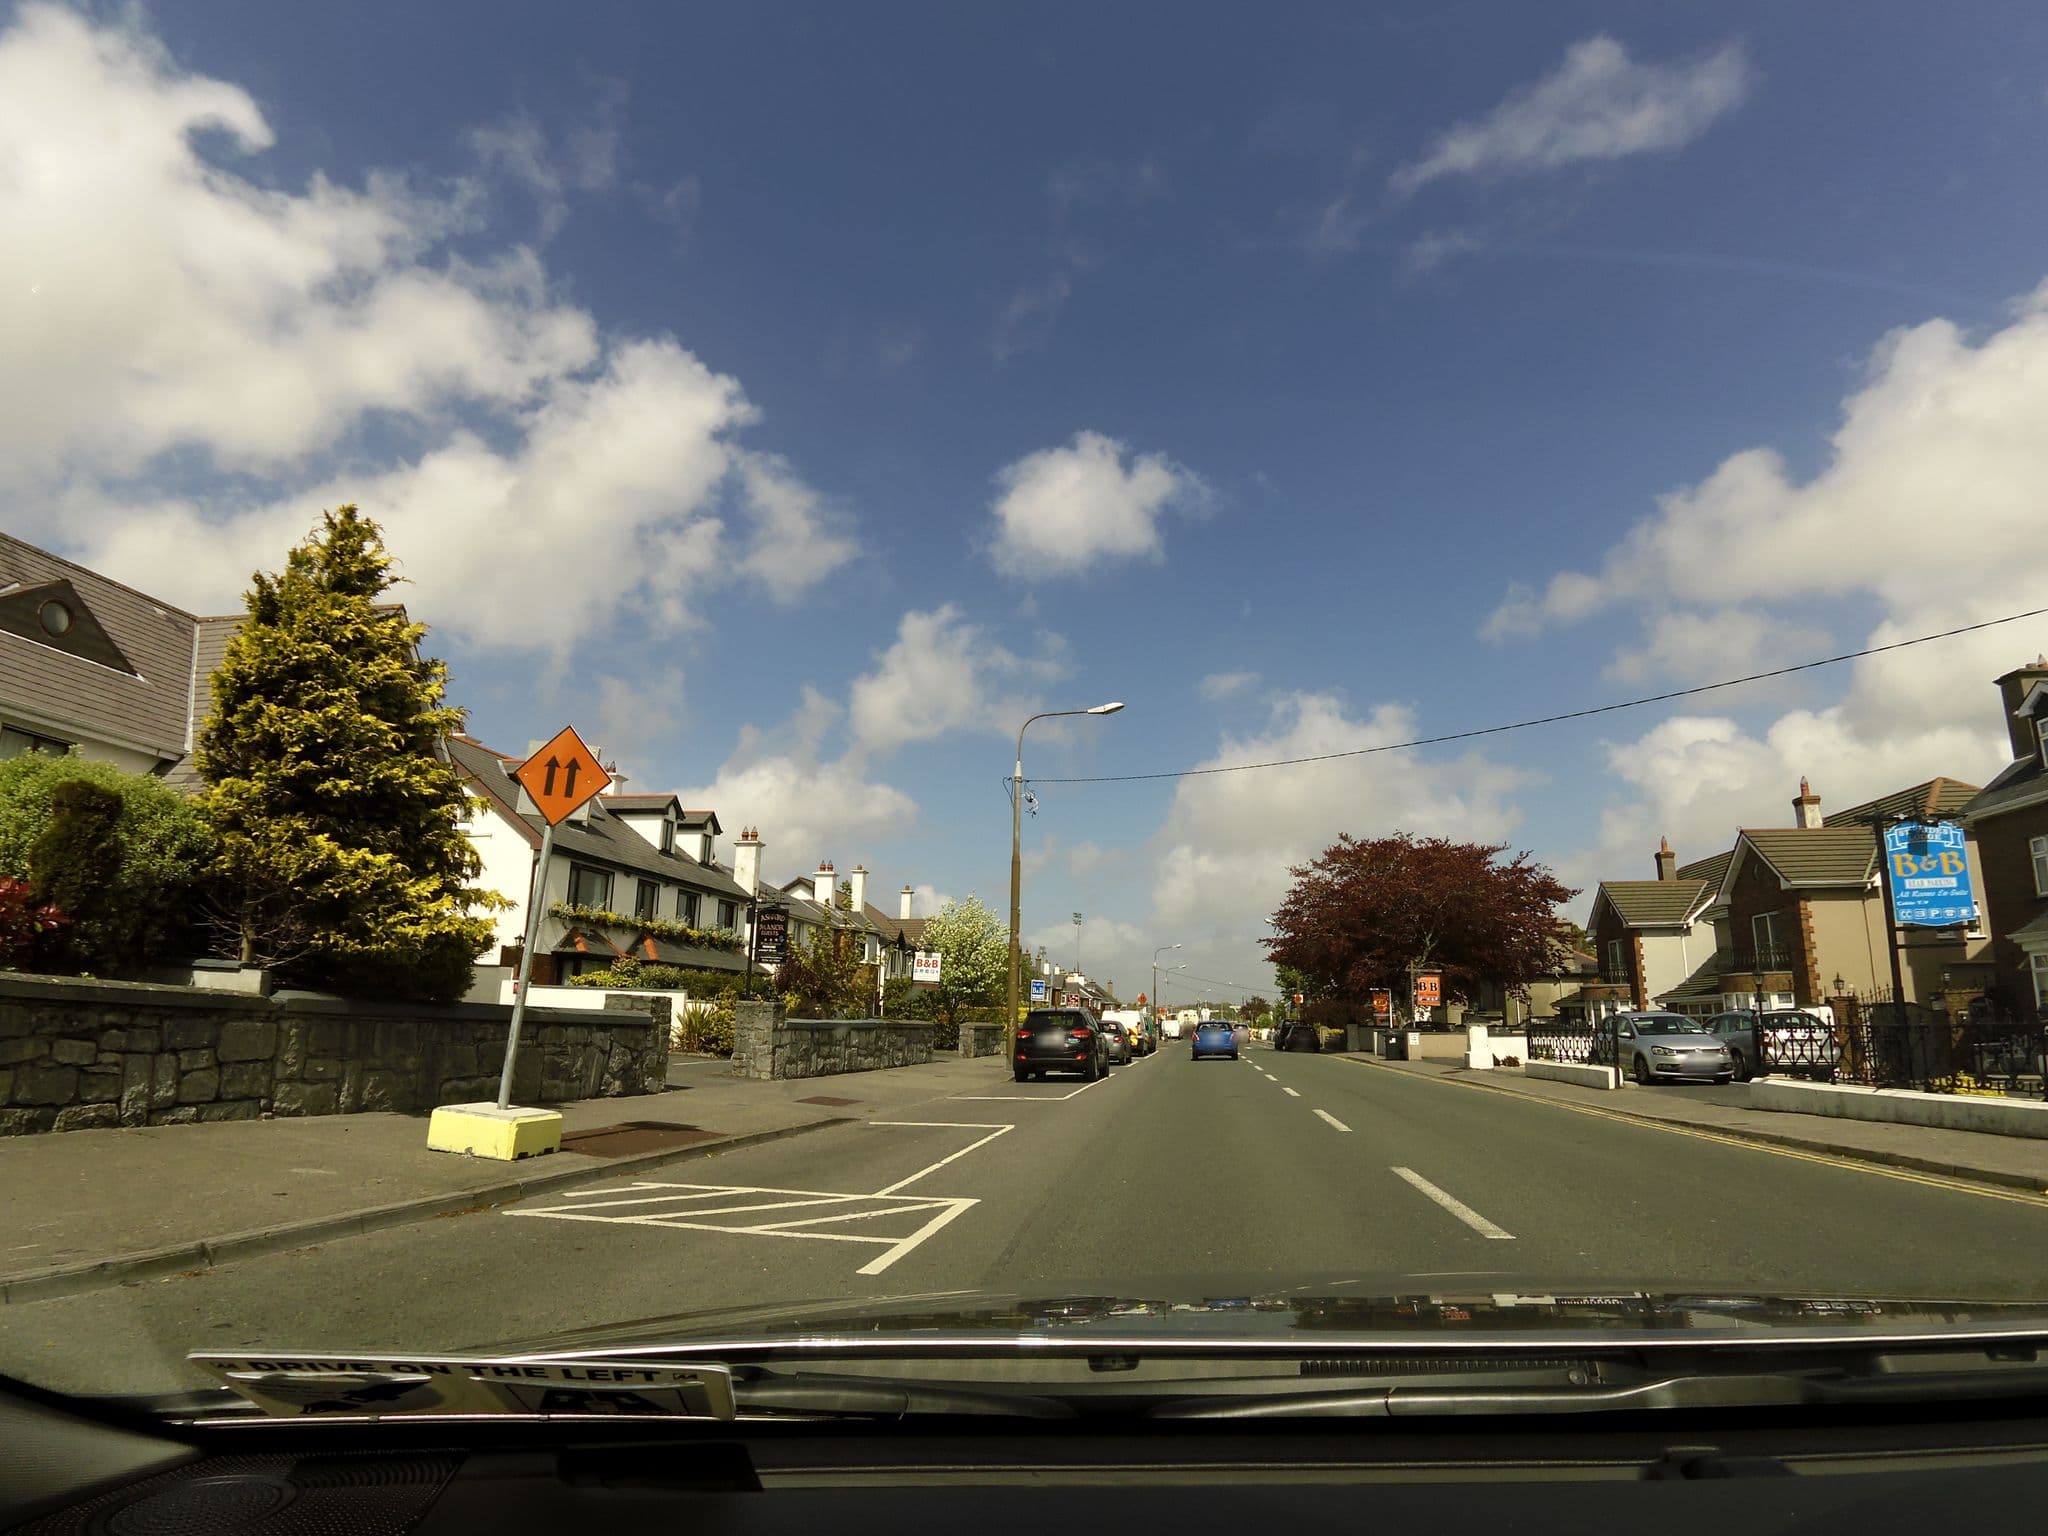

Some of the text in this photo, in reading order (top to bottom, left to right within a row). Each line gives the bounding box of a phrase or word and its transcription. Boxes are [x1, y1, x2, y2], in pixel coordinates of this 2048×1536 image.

[1893, 851, 1965, 877] B&B
[916, 959, 938, 968] B&B
[247, 1362, 378, 1374] DRIVE
[390, 1365, 453, 1375] ON
[462, 1365, 550, 1378] THE
[561, 1367, 661, 1382] LEFT
